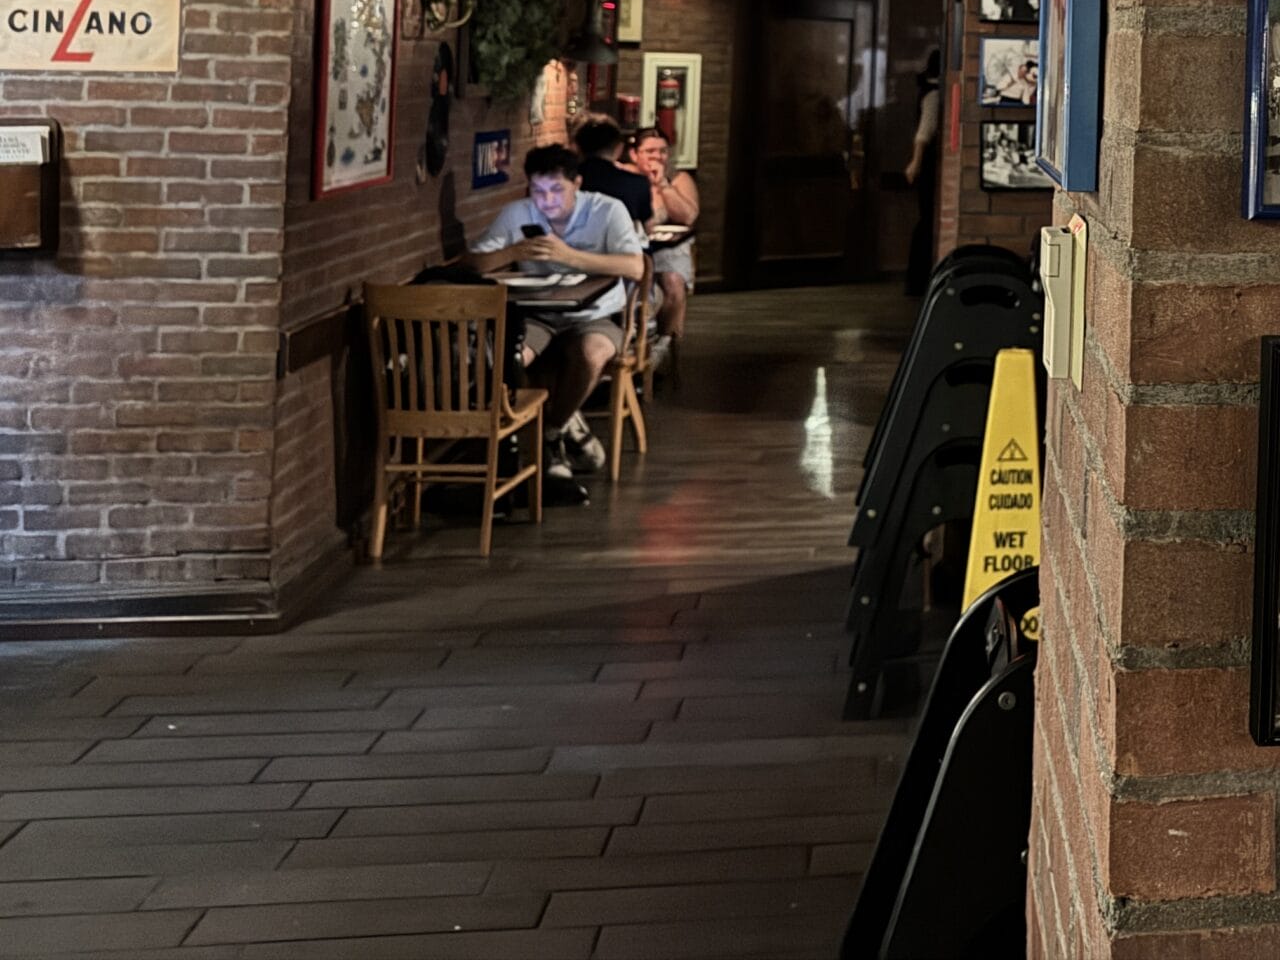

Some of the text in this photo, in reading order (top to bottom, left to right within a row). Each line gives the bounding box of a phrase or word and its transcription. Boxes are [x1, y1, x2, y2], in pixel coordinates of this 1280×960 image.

[990, 468, 1033, 485] CAUTION
[989, 493, 1033, 510] CUIDADO
[993, 531, 1027, 548] WET
[983, 555, 1035, 573] FLOOR
